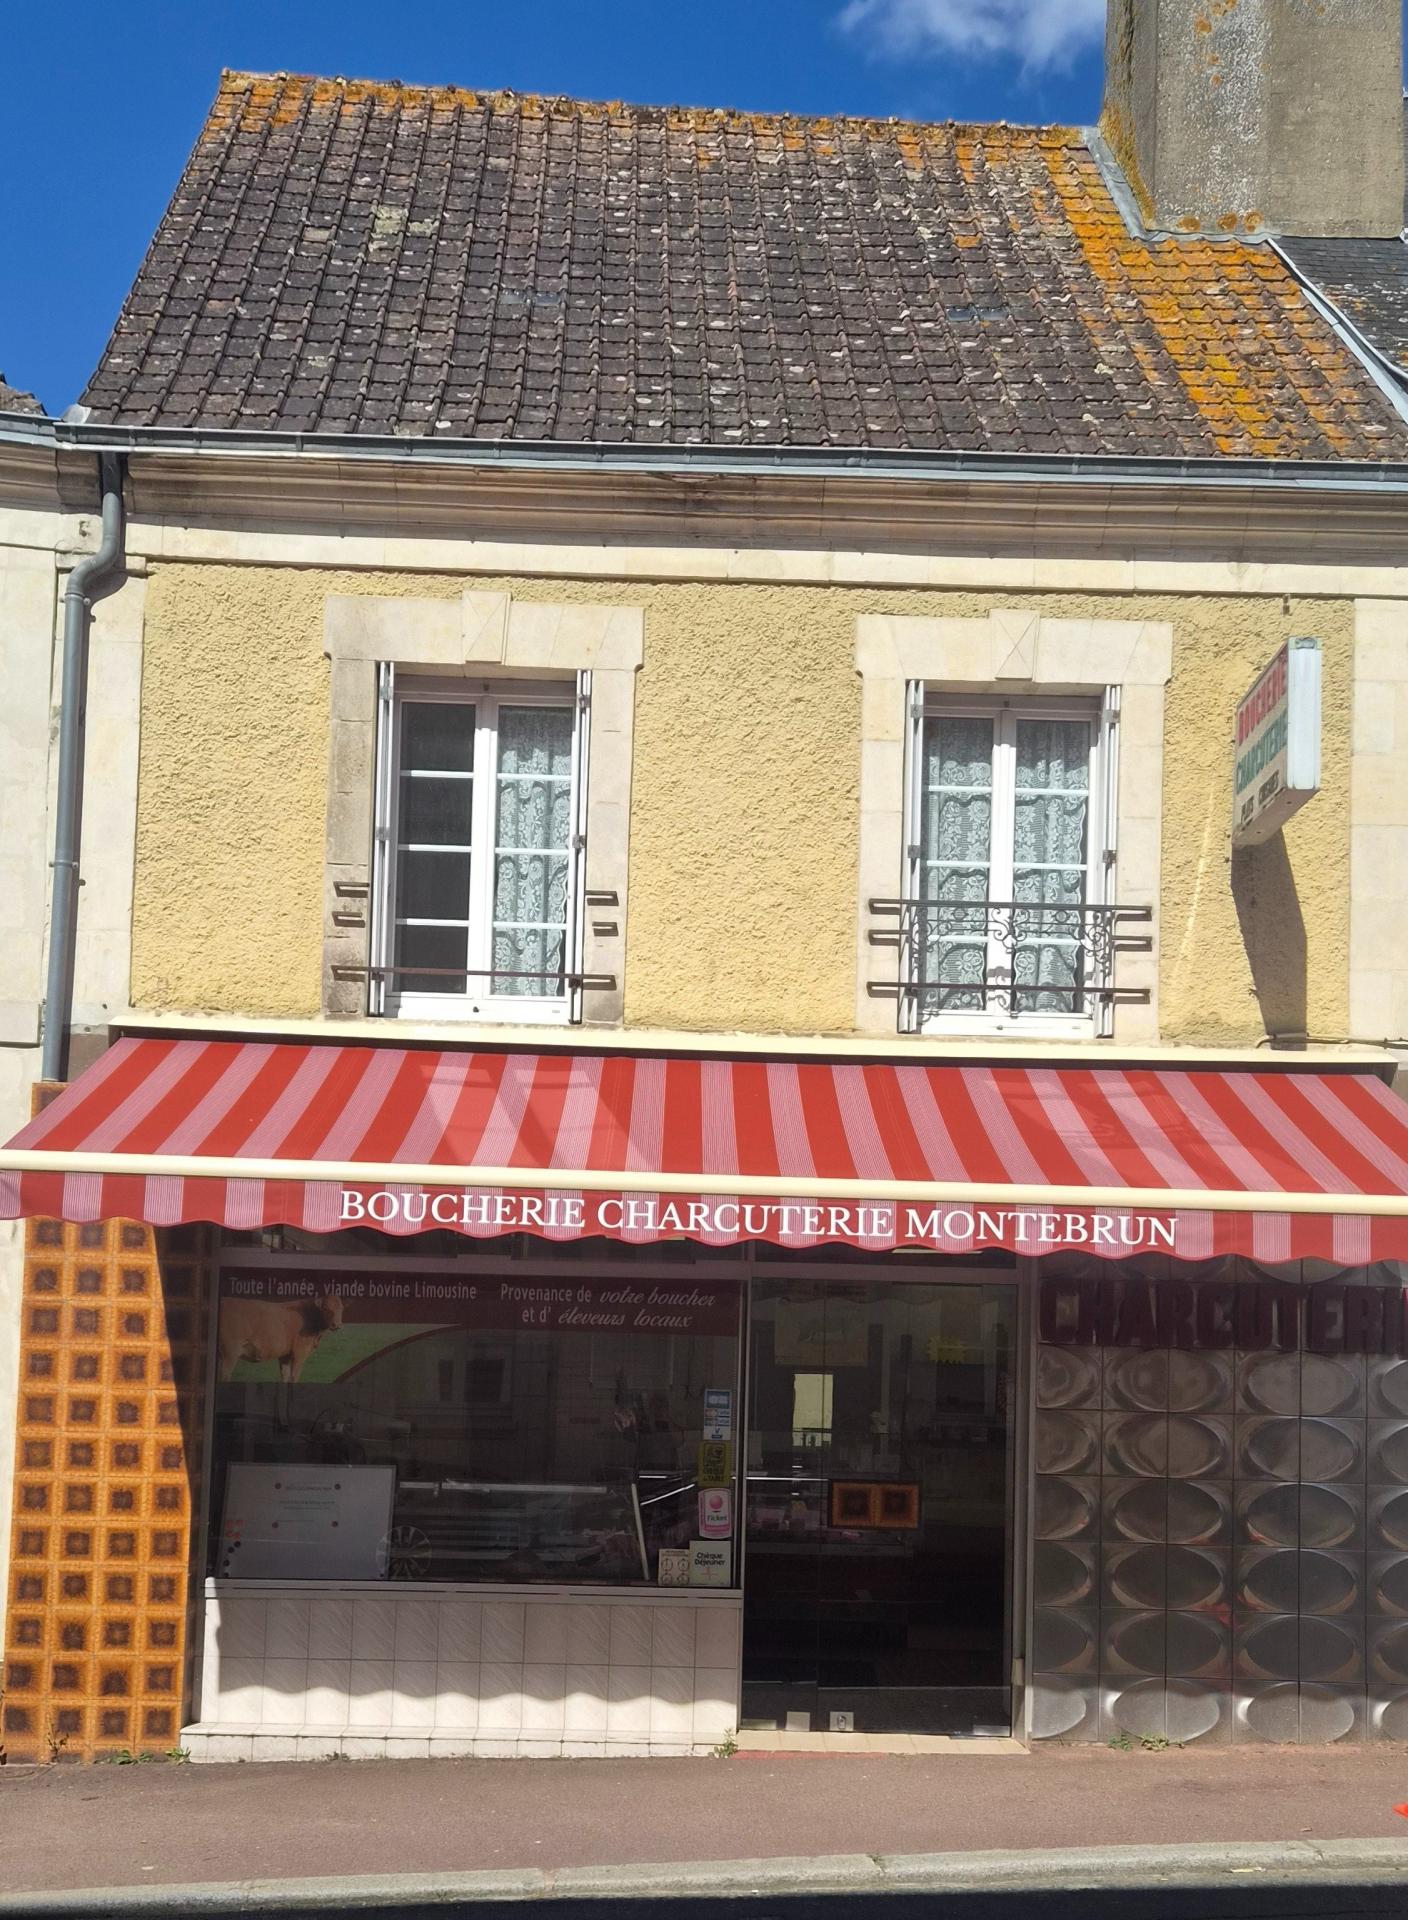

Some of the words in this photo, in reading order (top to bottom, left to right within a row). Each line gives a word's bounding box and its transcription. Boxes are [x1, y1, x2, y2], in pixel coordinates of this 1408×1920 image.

[339, 1190, 586, 1228] BOUCHERIE
[597, 1200, 893, 1238] CHARCUTERIE
[904, 1208, 1180, 1247] MONTEBRUN
[229, 1276, 264, 1295] Toute
[268, 1277, 319, 1298] l'année,
[323, 1279, 365, 1297] viande
[369, 1280, 409, 1298] bovine
[414, 1281, 477, 1300] Limousine
[501, 1283, 573, 1302] Provenance
[577, 1285, 592, 1302] de
[599, 1286, 645, 1305] votre
[647, 1287, 716, 1306] boucher
[521, 1308, 535, 1323] et
[558, 1306, 625, 1326] éleveurs
[633, 1308, 693, 1328] locaux
